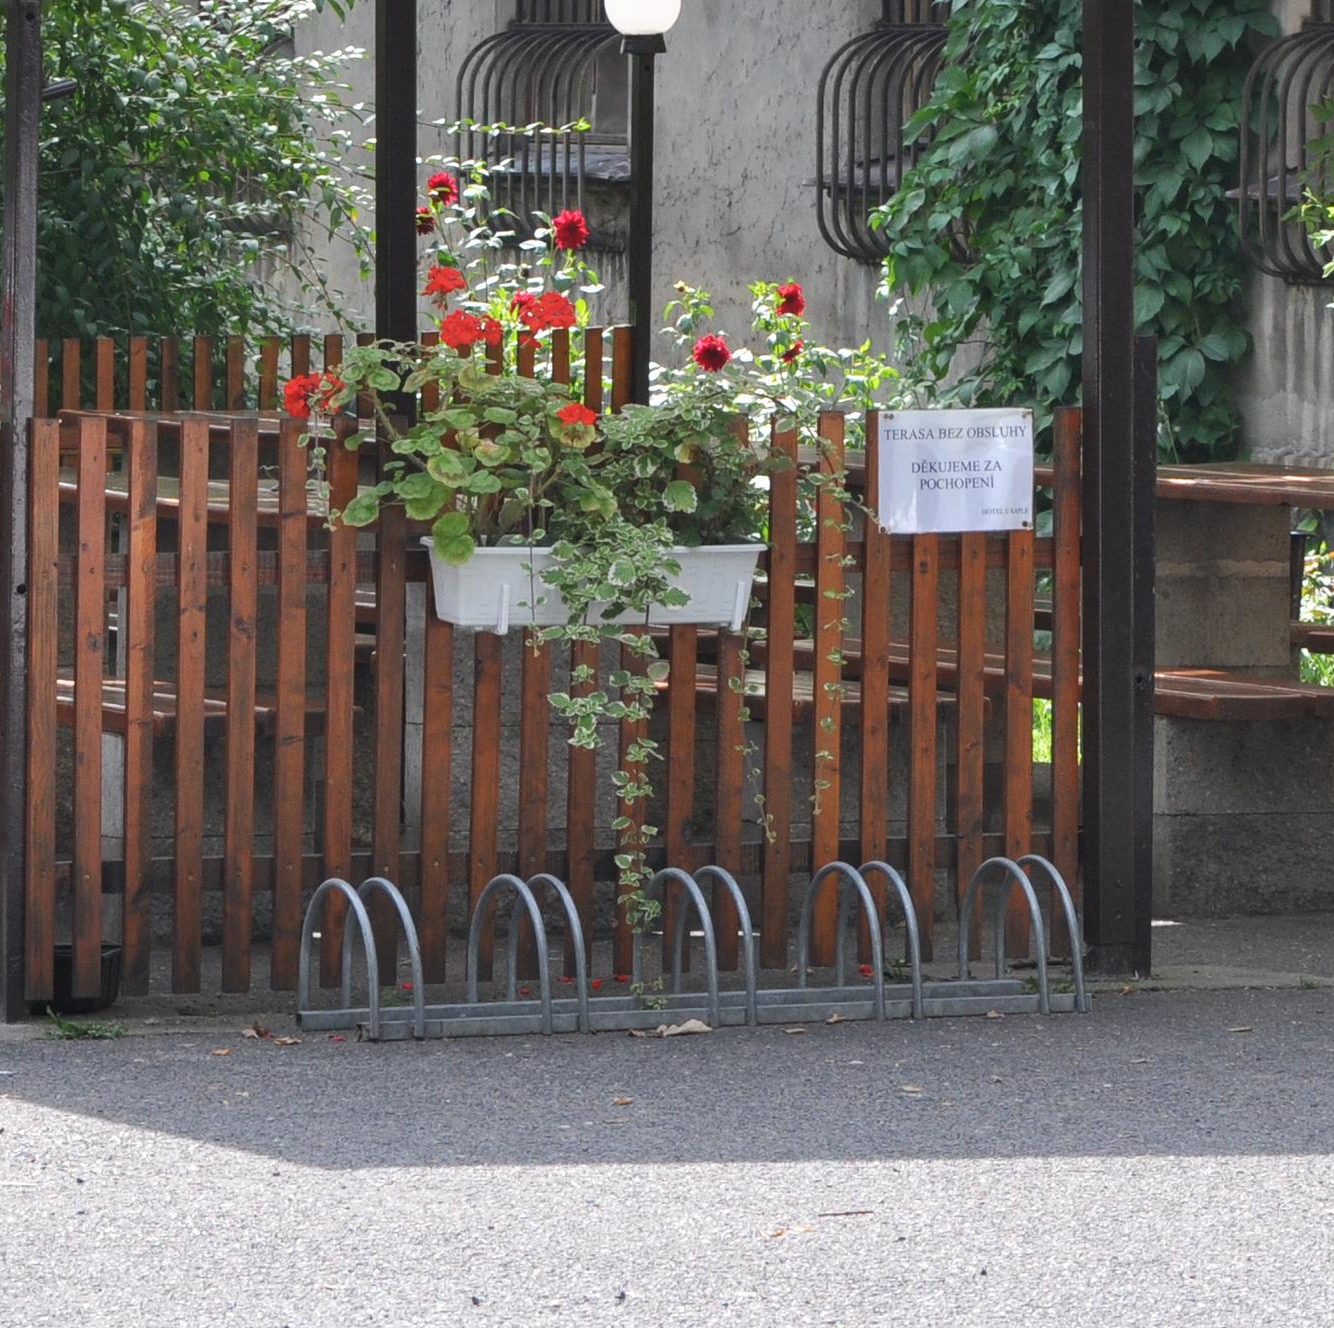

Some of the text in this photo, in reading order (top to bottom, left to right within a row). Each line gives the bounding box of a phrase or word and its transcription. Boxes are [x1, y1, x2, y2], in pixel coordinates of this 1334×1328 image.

[884, 425, 1027, 441] TERASA BEZ OBSLUHY
[911, 458, 1002, 473] DĚKUJEME ZA
[920, 476, 994, 490] POCHOPENÍ
